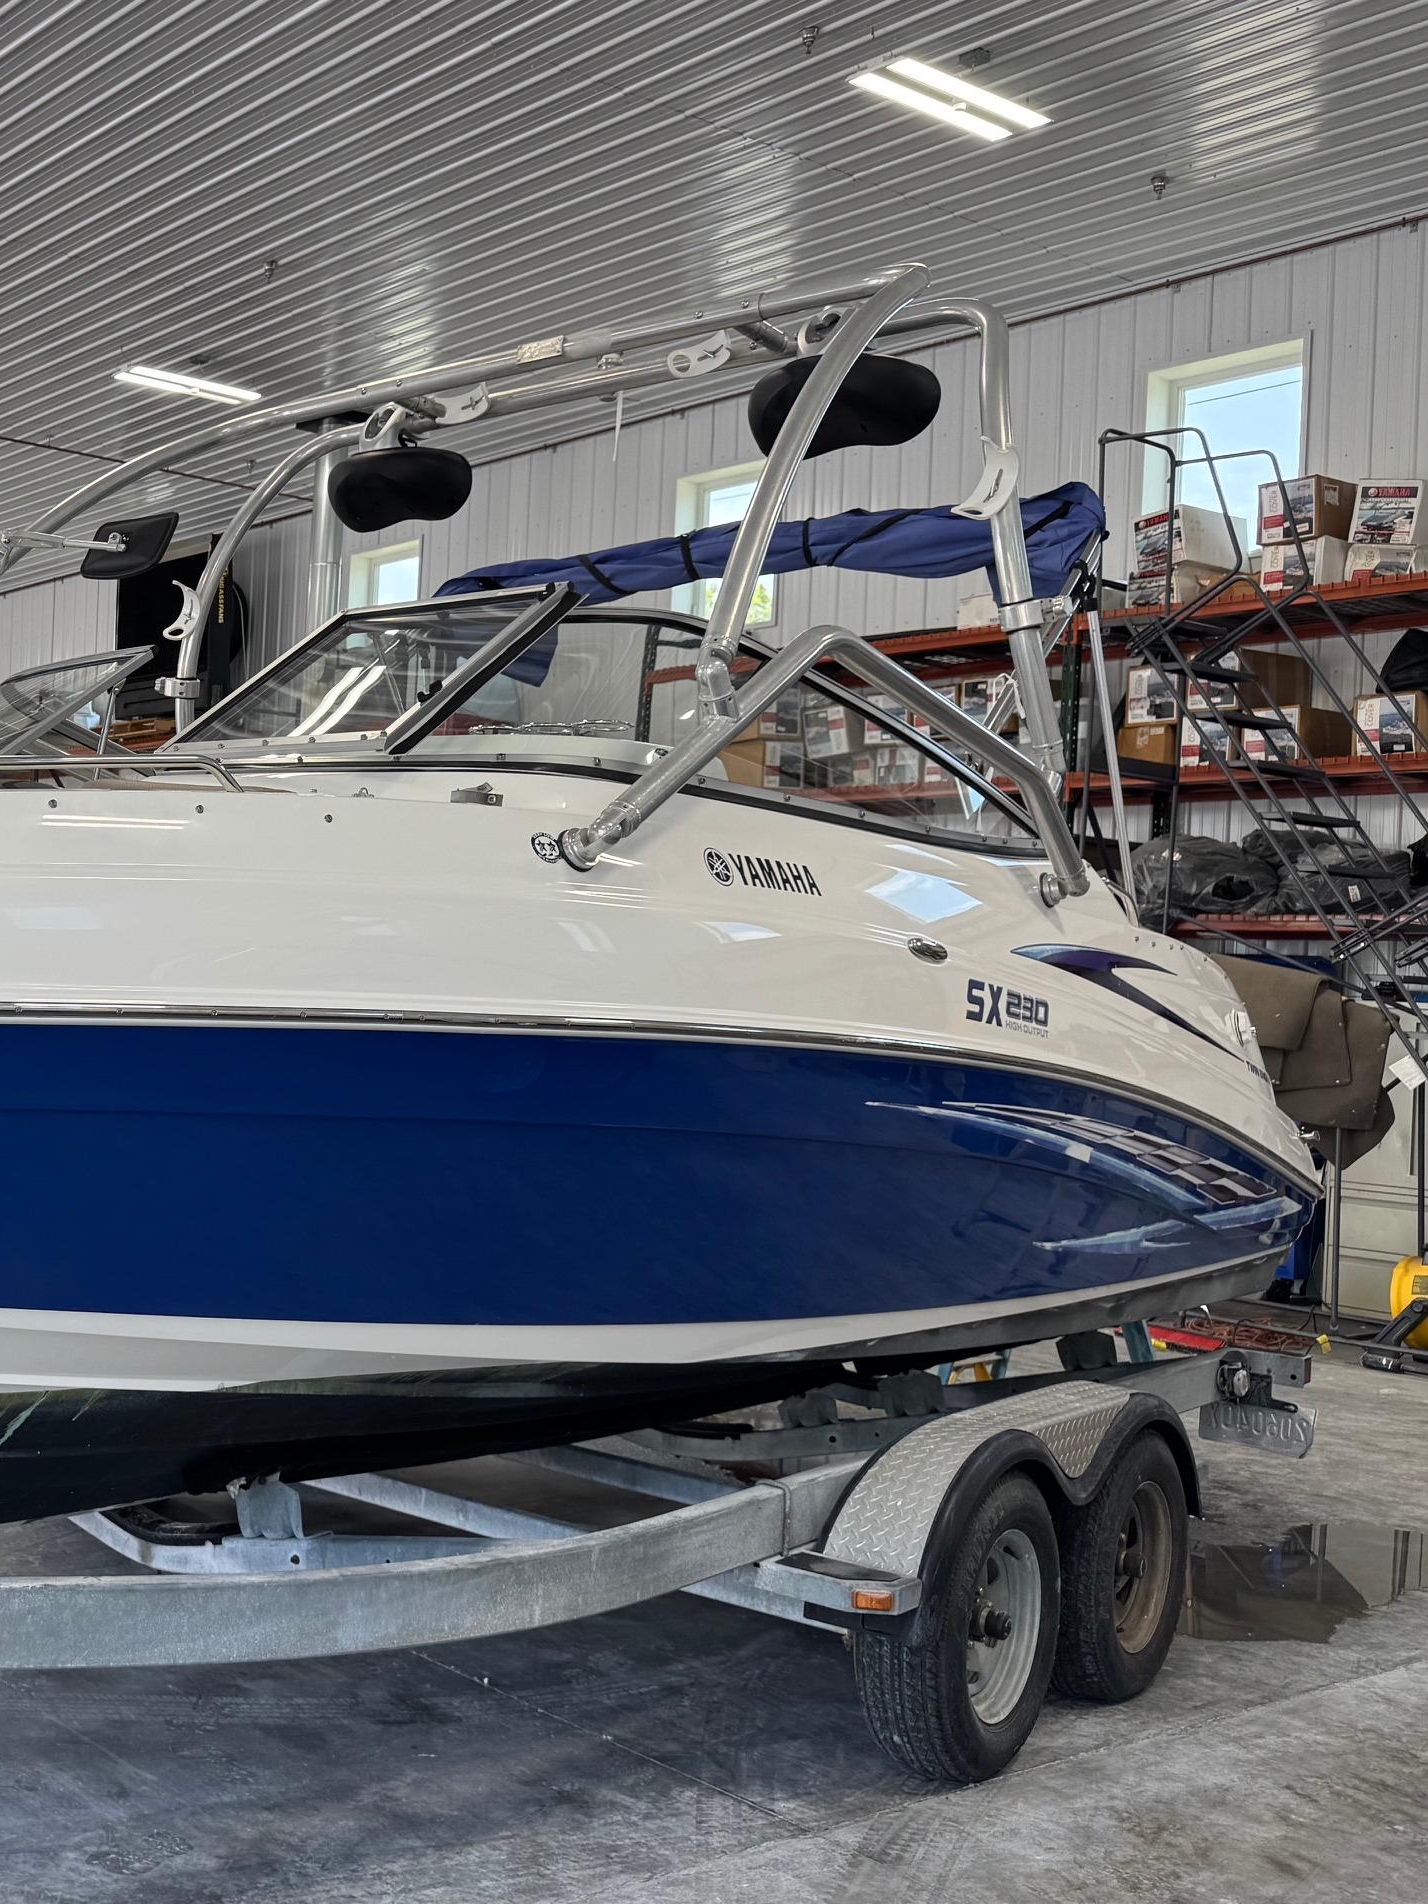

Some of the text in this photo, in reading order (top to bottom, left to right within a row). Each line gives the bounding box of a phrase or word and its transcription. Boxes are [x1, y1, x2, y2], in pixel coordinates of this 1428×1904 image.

[728, 853, 822, 896] YAMAHA
[1005, 1020, 1049, 1039] HIGH OUTPUT
